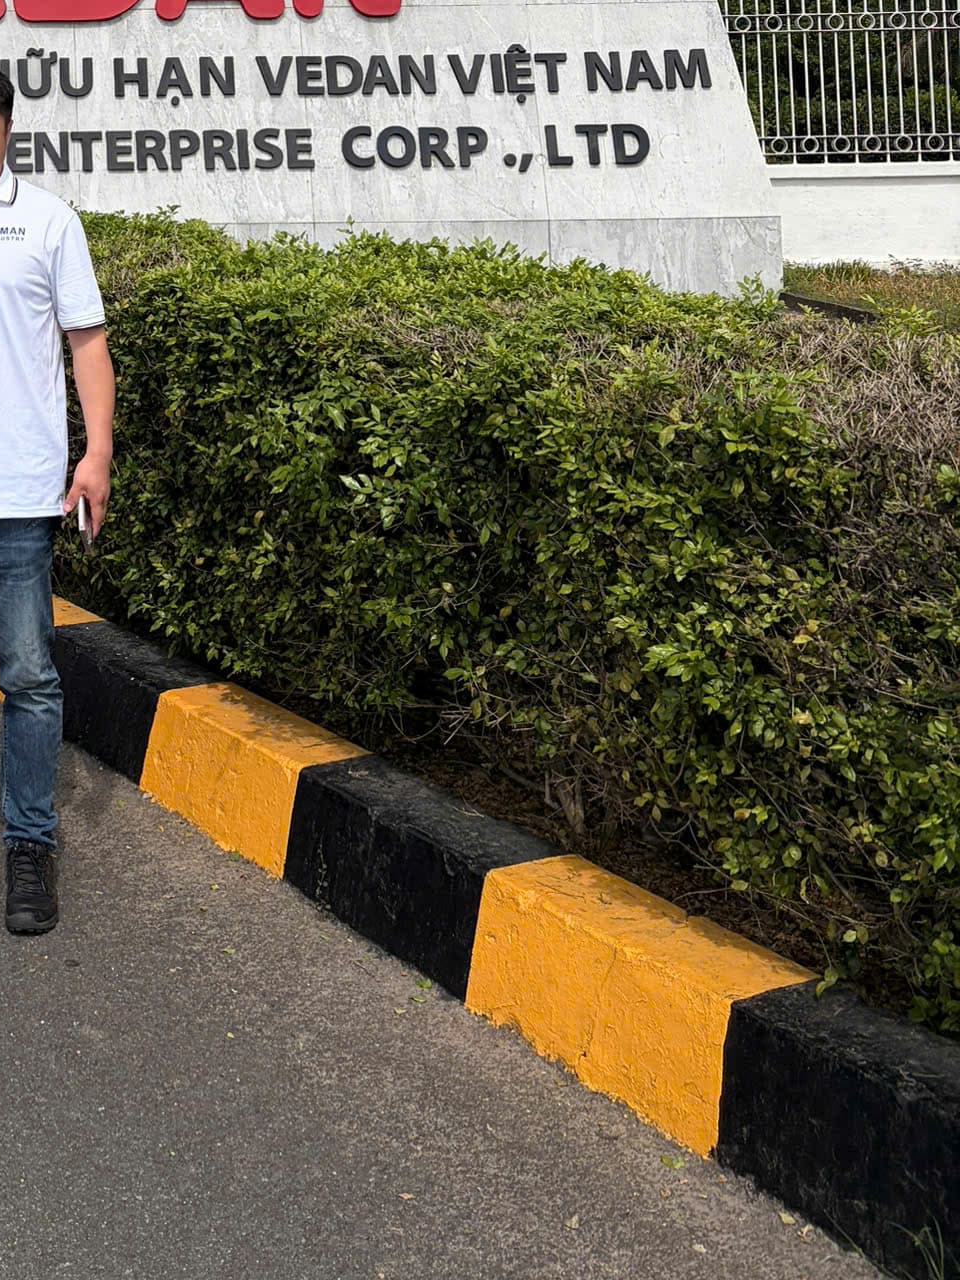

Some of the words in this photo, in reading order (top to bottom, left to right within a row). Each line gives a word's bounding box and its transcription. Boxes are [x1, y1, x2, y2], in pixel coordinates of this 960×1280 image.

[113, 55, 236, 107] HẠN
[255, 54, 437, 97] VEDAN
[446, 43, 568, 105] VIỆT
[583, 48, 713, 94] NAM
[5, 127, 315, 176] ENTERPRISE
